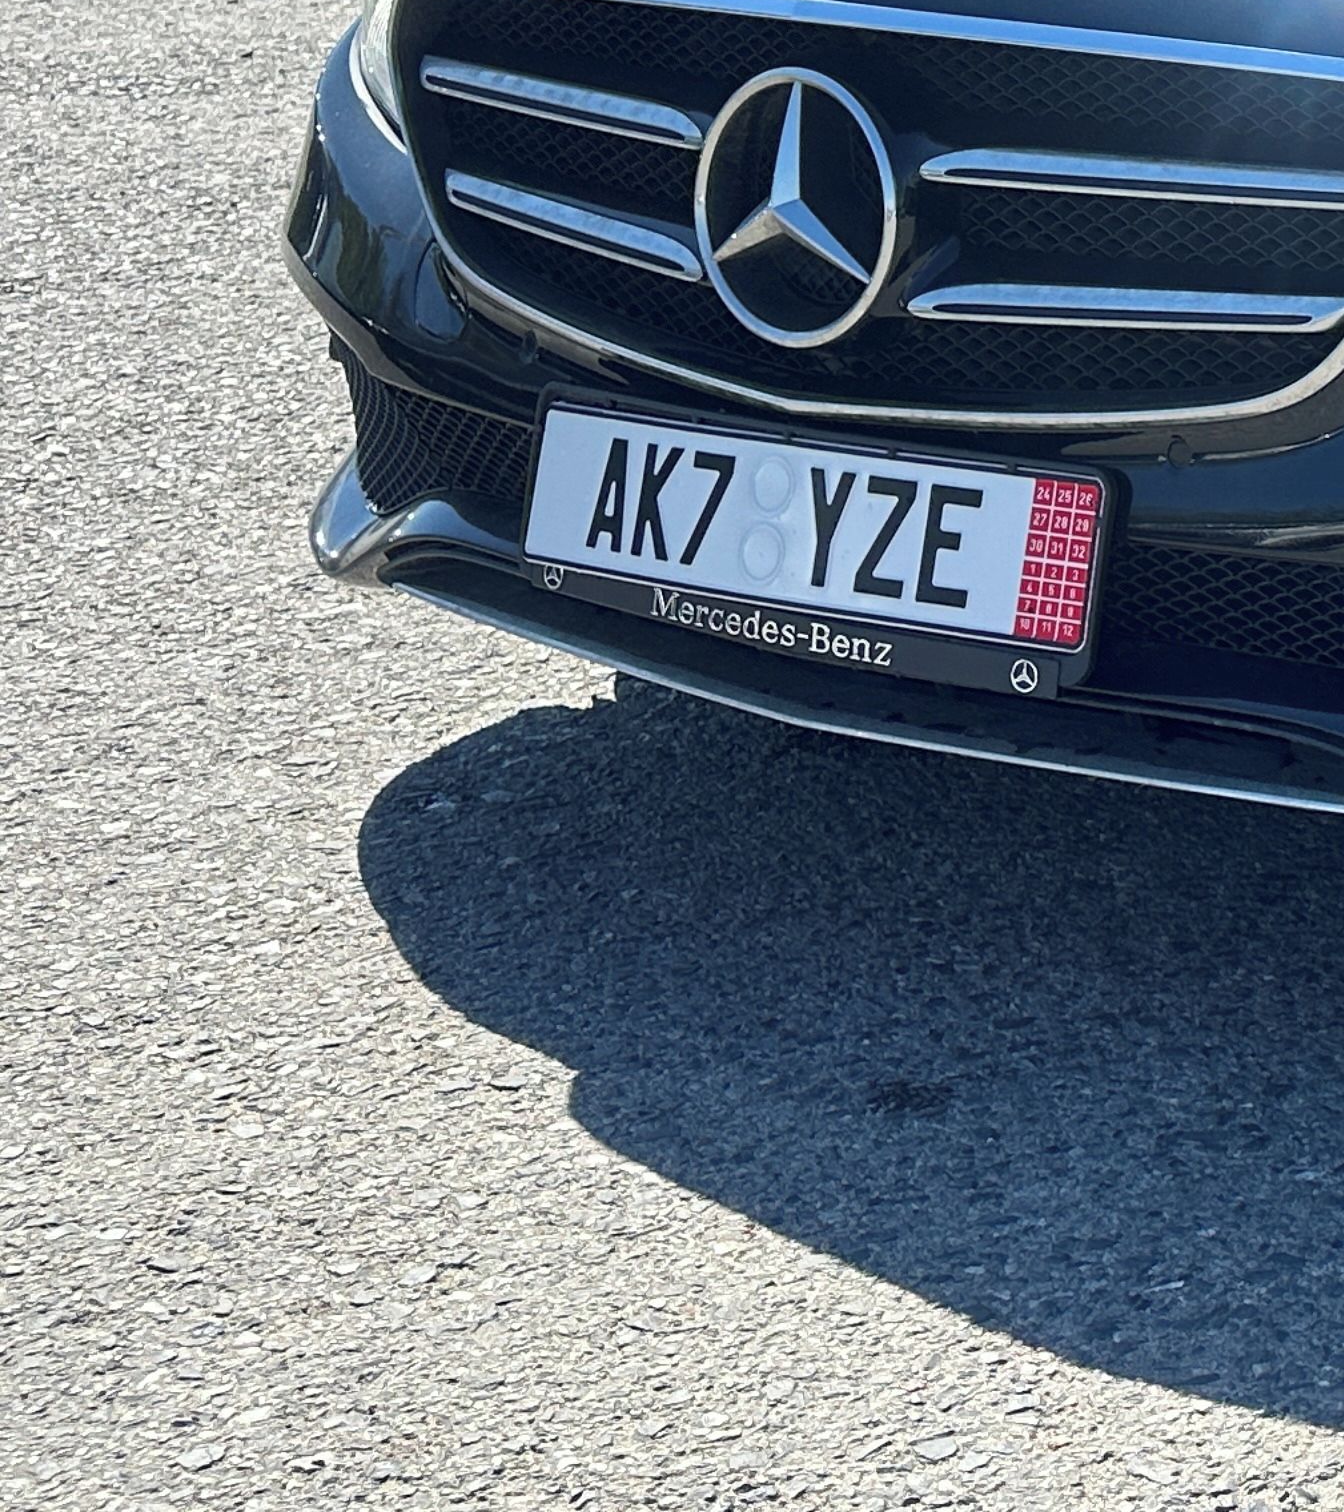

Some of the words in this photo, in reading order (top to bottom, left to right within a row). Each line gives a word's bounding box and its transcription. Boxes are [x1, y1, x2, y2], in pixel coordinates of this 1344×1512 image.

[1036, 486, 1050, 501] 24
[1058, 489, 1072, 503] 25
[585, 437, 736, 565] AK7
[811, 467, 984, 609] YZE
[1033, 512, 1047, 526] 27
[1029, 539, 1043, 553] 30
[1051, 541, 1063, 555] 31
[1072, 544, 1085, 559] 32
[650, 587, 893, 667] Mercedes-Benz
[1042, 621, 1051, 633] 11
[1062, 624, 1073, 637] 12
